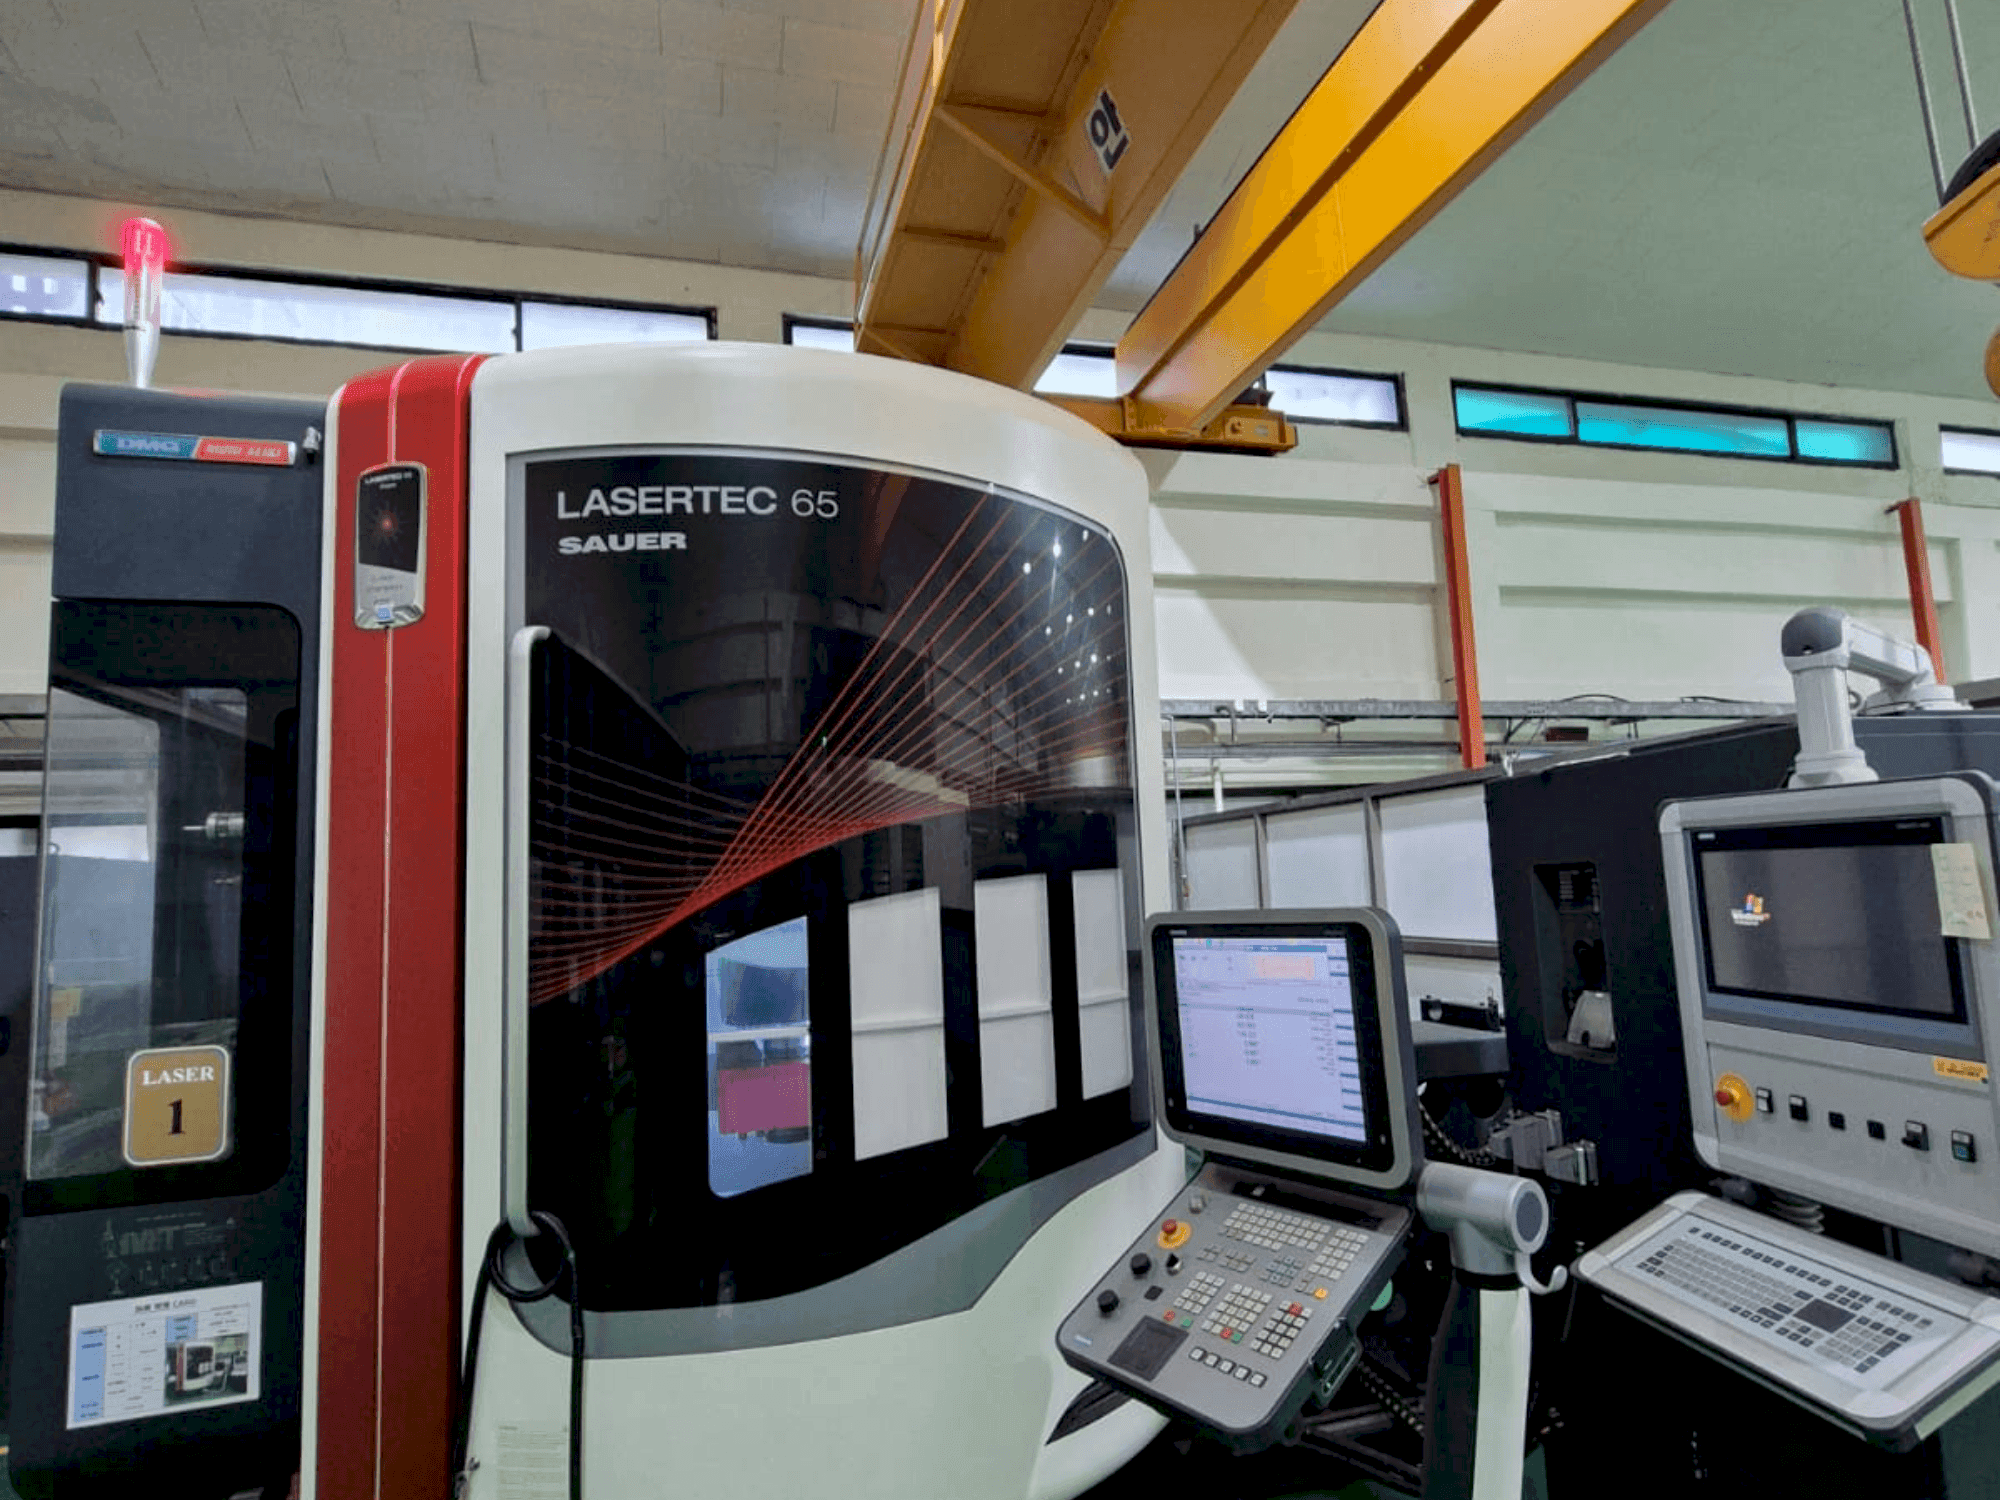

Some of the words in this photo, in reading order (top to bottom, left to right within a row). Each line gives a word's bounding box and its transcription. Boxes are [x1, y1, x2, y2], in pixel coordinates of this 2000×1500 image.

[557, 486, 778, 520] LASERTEC
[790, 490, 840, 518] 65
[558, 532, 687, 555] SAUER
[142, 1066, 215, 1086] LASER
[167, 1098, 187, 1136] 1
